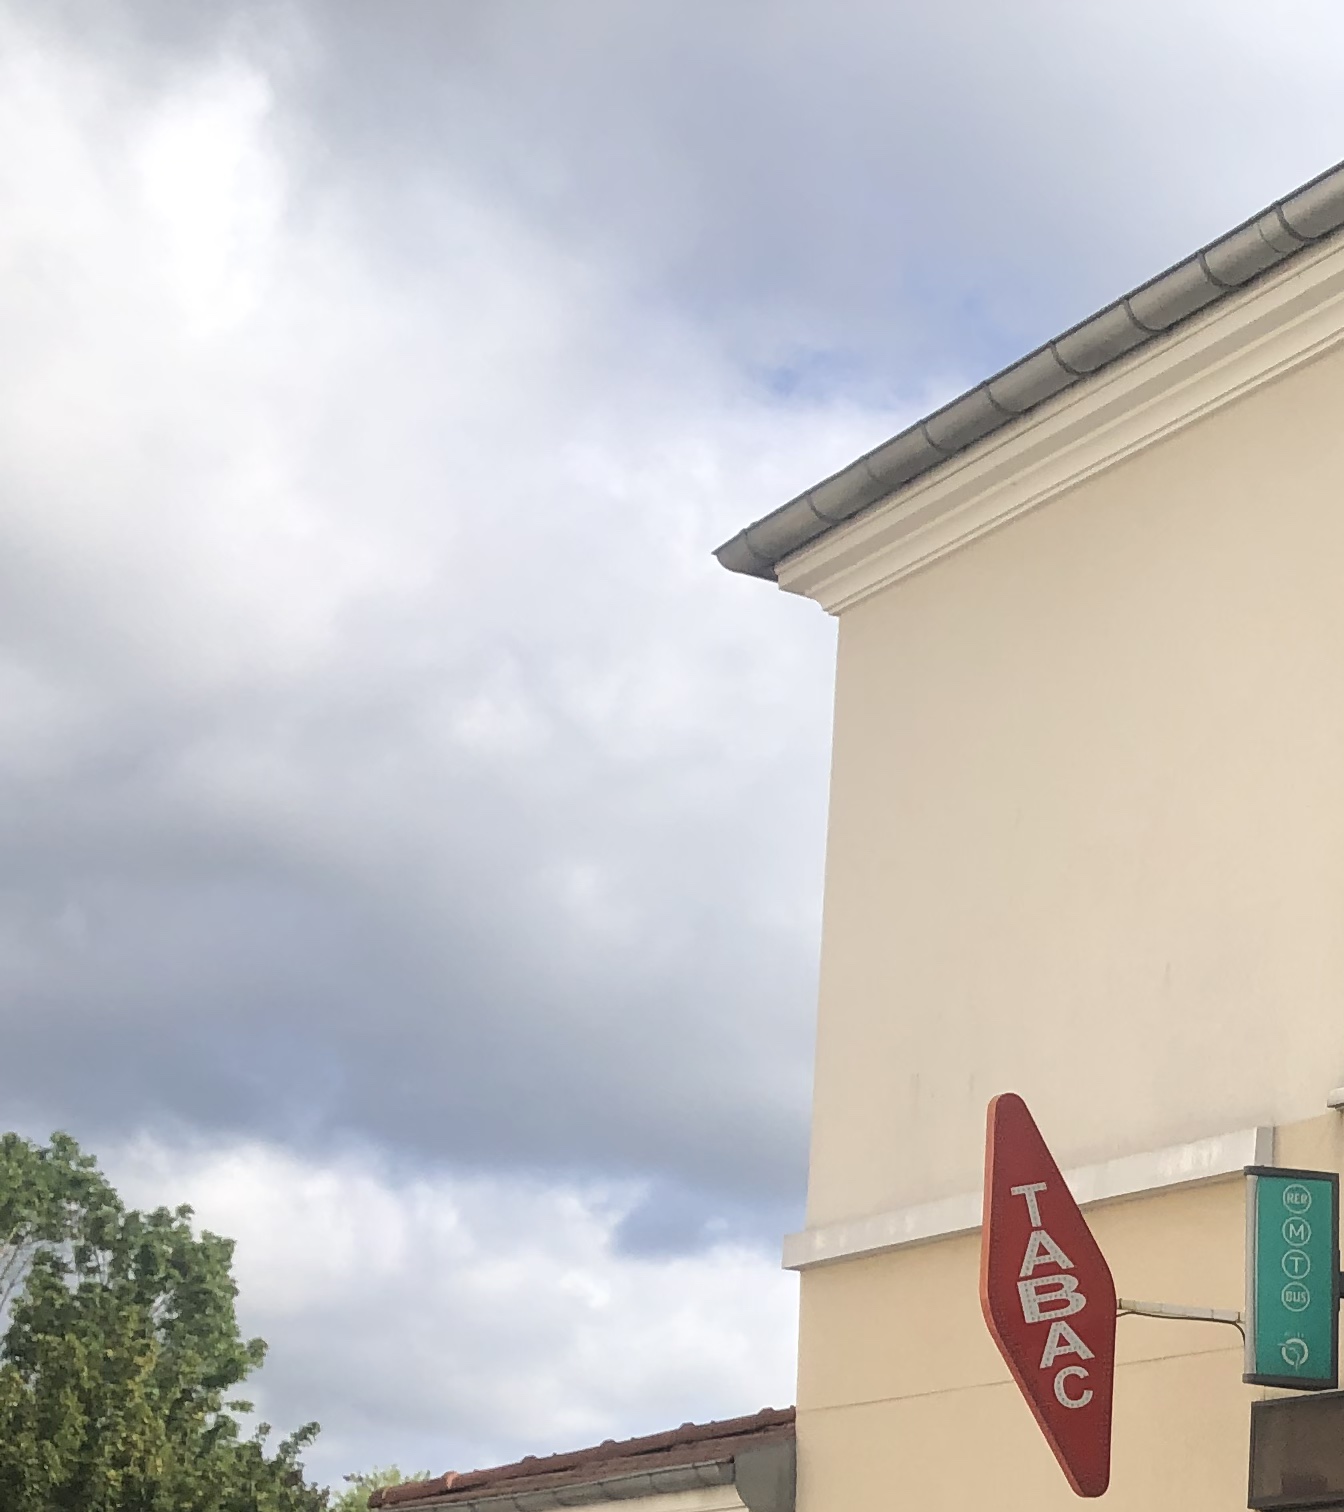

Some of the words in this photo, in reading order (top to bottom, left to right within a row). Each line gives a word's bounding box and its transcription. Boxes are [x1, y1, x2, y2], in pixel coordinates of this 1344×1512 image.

[1286, 1192, 1309, 1205] RER
[1289, 1223, 1305, 1240] M
[1289, 1256, 1304, 1273] T
[1010, 1181, 1096, 1409] TABAC
[1285, 1290, 1307, 1303] BUS
